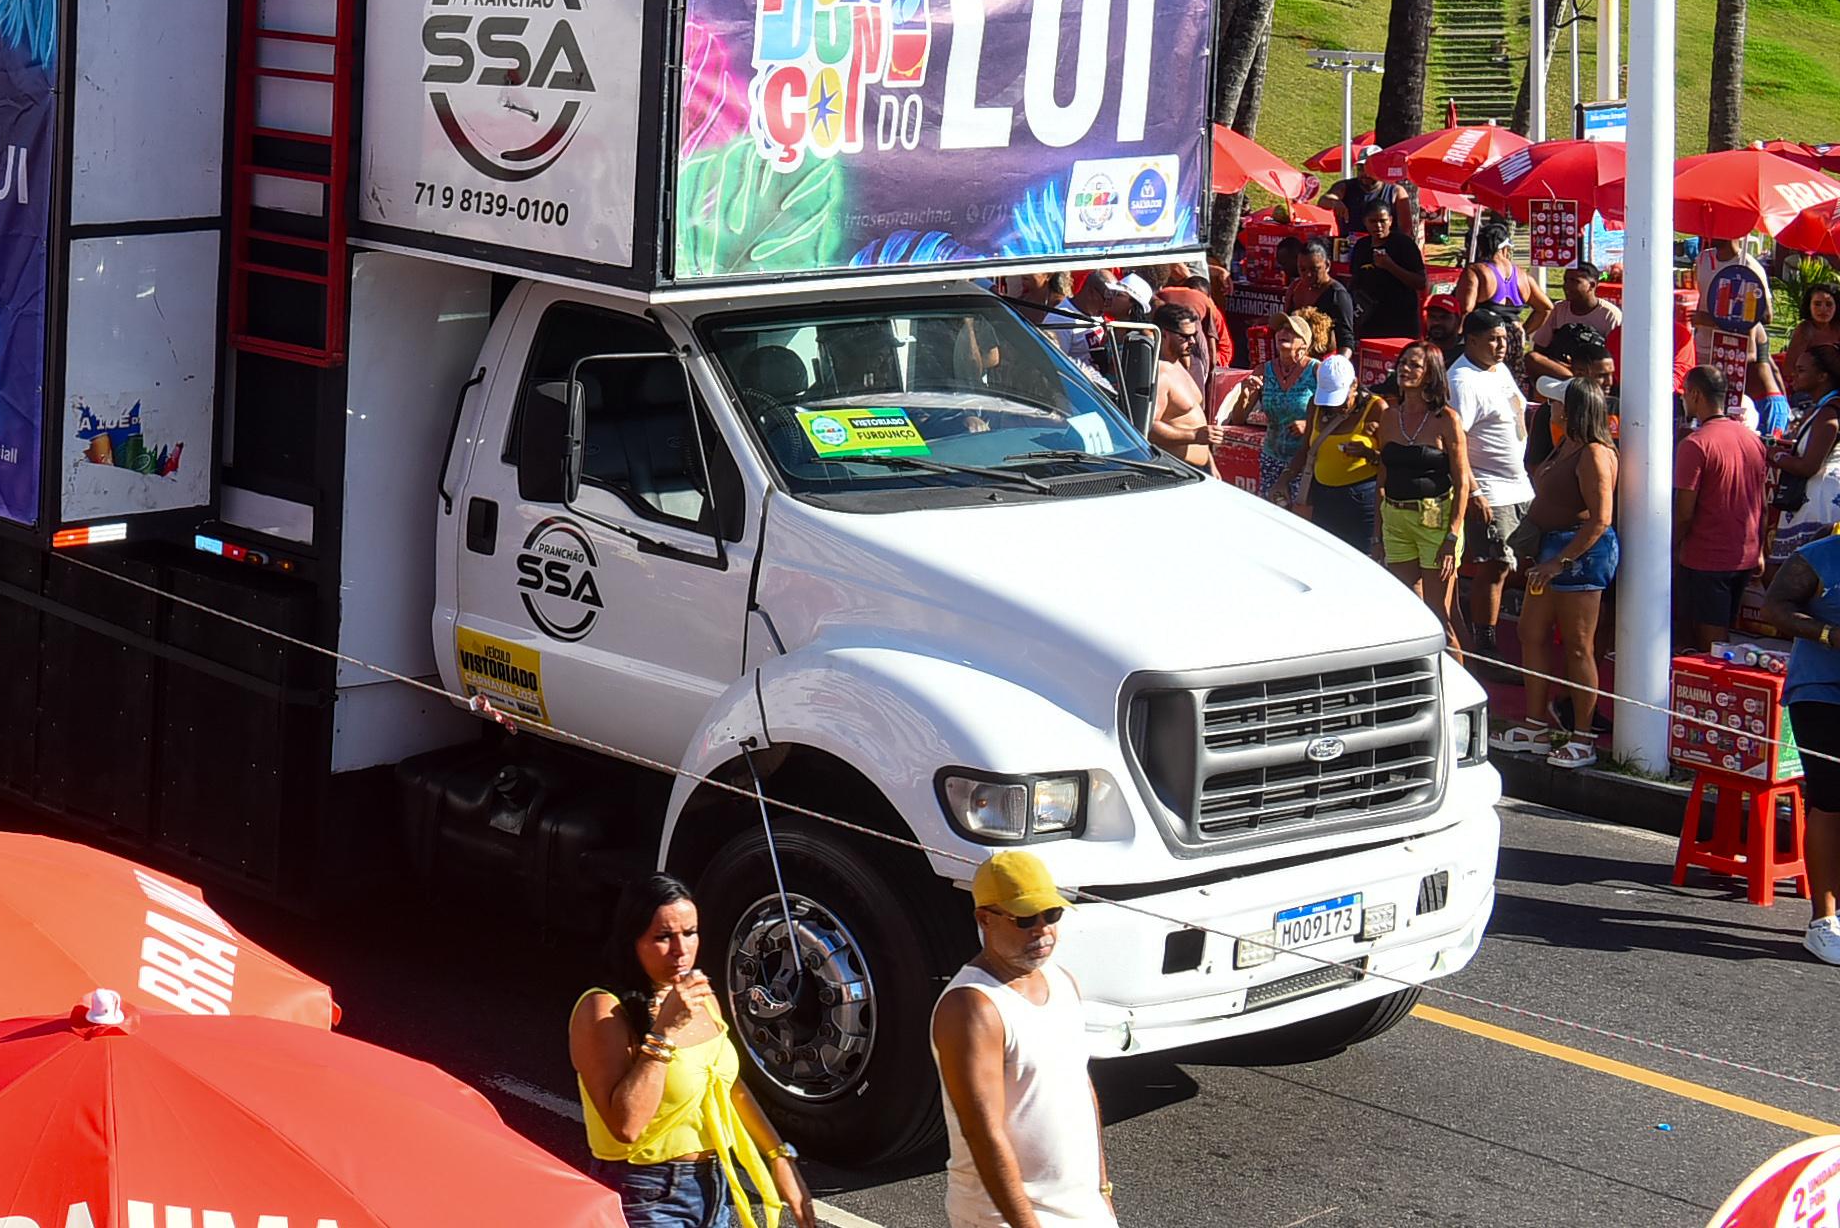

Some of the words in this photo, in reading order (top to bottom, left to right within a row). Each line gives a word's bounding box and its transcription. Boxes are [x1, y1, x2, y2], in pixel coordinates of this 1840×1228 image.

[421, 14, 596, 93] SSA
[877, 94, 922, 151] DO
[414, 182, 436, 207] 71
[441, 185, 454, 209] 9
[459, 189, 569, 226] 8139-0100
[857, 430, 916, 441] FURDUNÇO
[539, 543, 584, 563] PRANCHÃO
[517, 553, 604, 608] SSA
[484, 644, 510, 663] VEÍCULO
[460, 650, 538, 691] VISTORIADO
[465, 673, 515, 694] CARNAVAL
[1676, 685, 1712, 703] BRAHMA
